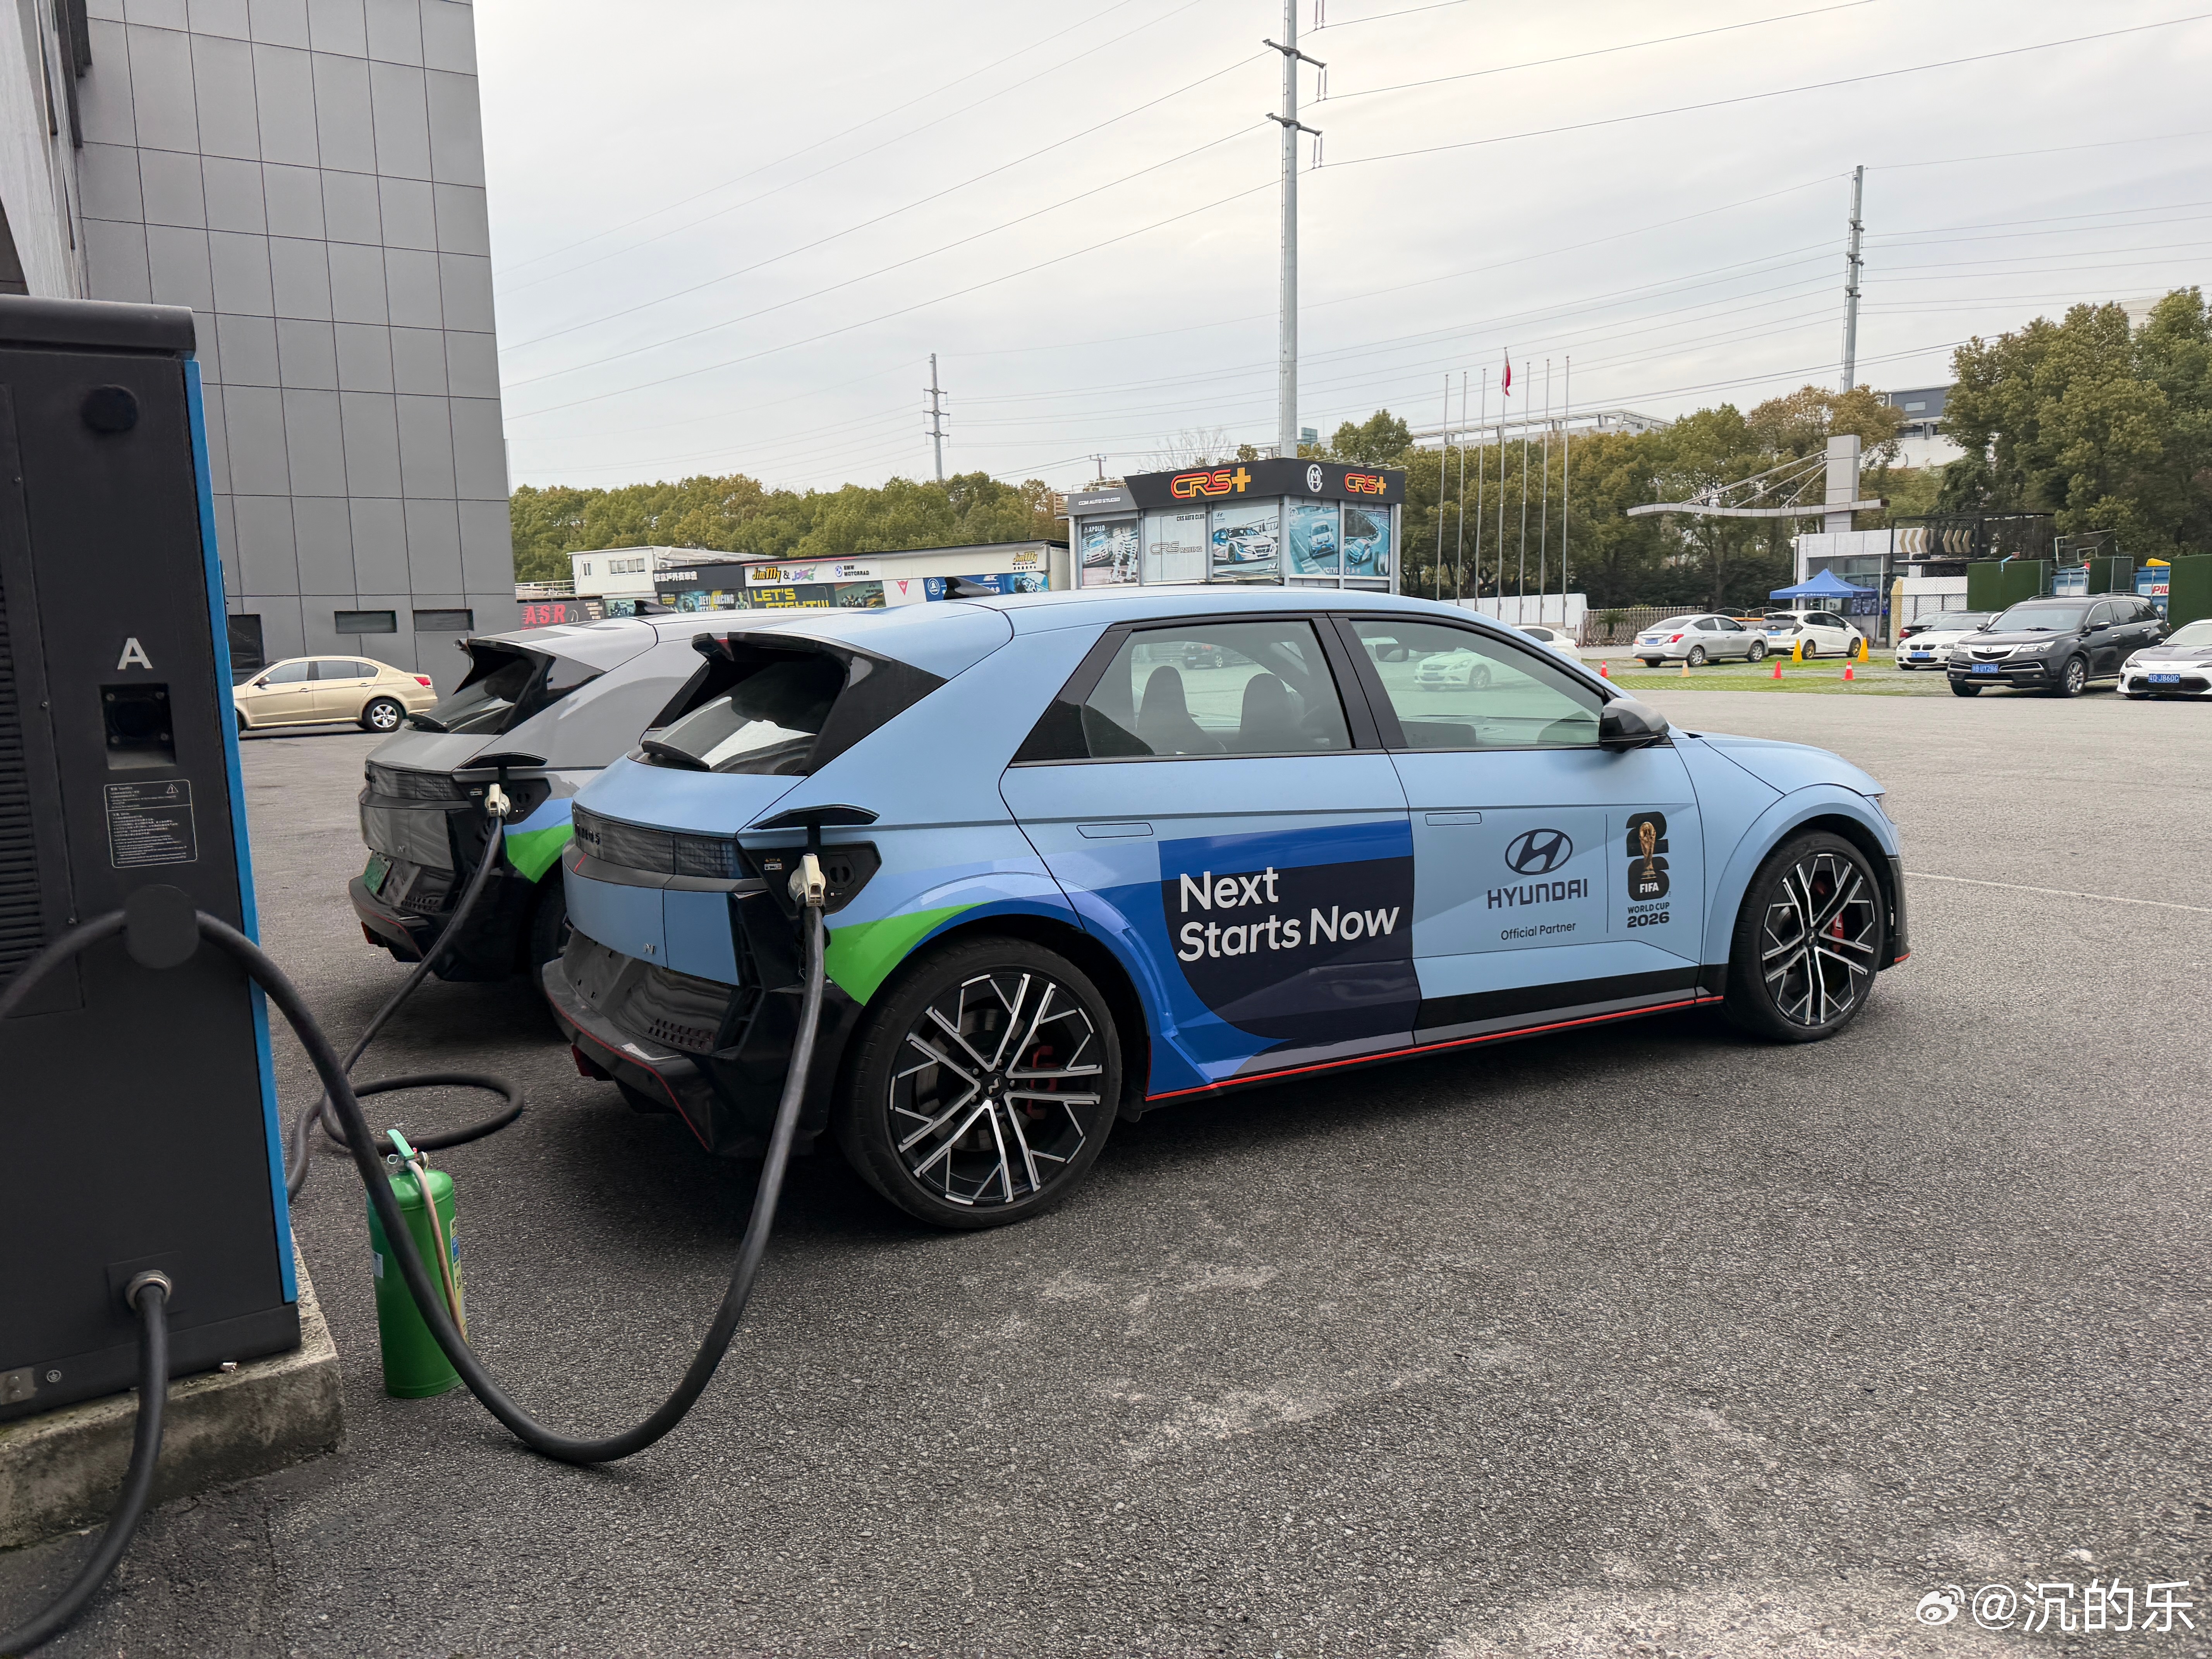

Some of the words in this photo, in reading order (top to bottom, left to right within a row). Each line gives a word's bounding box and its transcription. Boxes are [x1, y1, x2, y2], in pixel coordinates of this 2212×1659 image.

[1150, 541, 1179, 555] CRS
[783, 570, 790, 579] &
[753, 588, 796, 602] LET'S
[522, 604, 566, 624] ASR
[117, 637, 153, 670] A
[1180, 867, 1279, 912] Next
[1487, 879, 1588, 909] HYUNDAI
[1640, 882, 1659, 893] FIFA
[1628, 904, 1654, 914] WORLD
[1656, 902, 1669, 910] CUP
[1627, 912, 1669, 928] 2026
[1178, 915, 1301, 962] Starts
[1310, 906, 1400, 945] Now
[1501, 926, 1537, 940] Official
[1540, 923, 1576, 935] Partner
